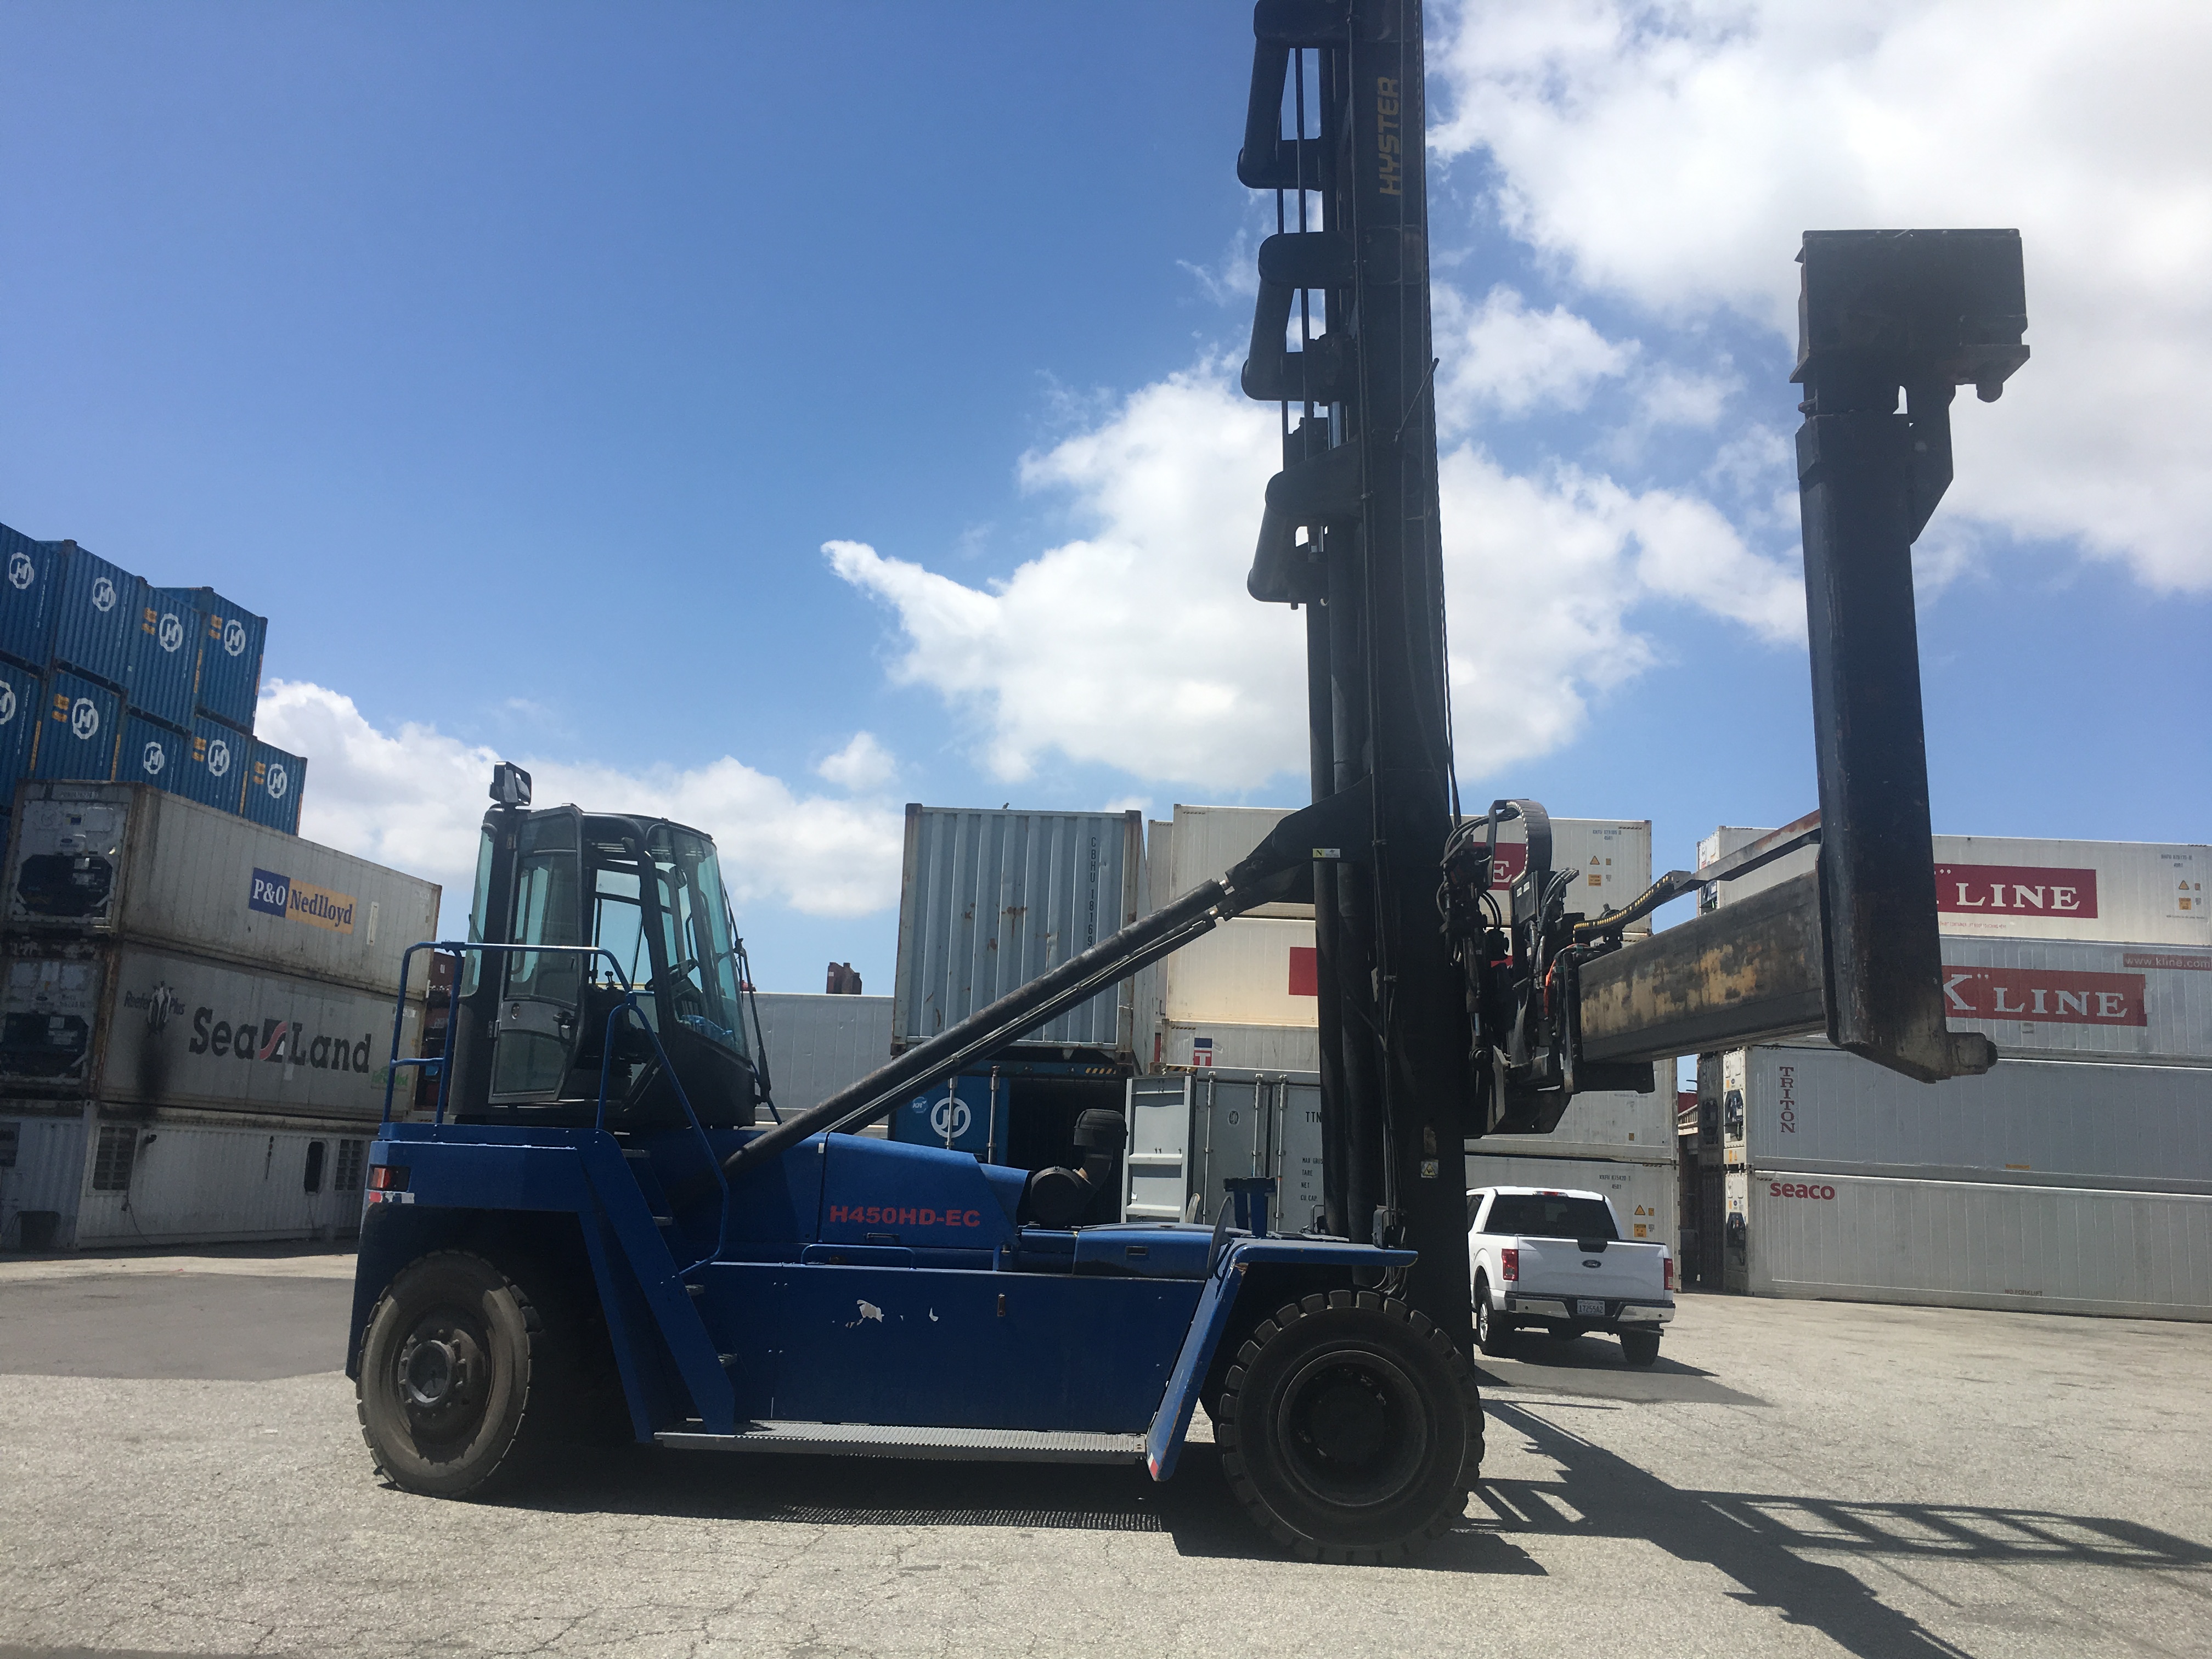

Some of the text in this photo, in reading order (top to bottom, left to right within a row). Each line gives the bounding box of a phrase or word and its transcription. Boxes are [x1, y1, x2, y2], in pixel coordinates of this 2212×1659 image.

[1378, 77, 1402, 195] HYSTER
[253, 878, 353, 927] P&O Nedlloyd
[1956, 883, 2080, 910] LINE
[2125, 957, 2210, 968] www.kline.com
[1994, 988, 2128, 1017] LINE
[189, 1007, 371, 1074] Sea Land
[1779, 1066, 1795, 1133] TRITON
[1305, 1111, 1322, 1123] TTN
[1770, 1182, 1835, 1200] seaco
[830, 1205, 980, 1227] H450HD-EC
